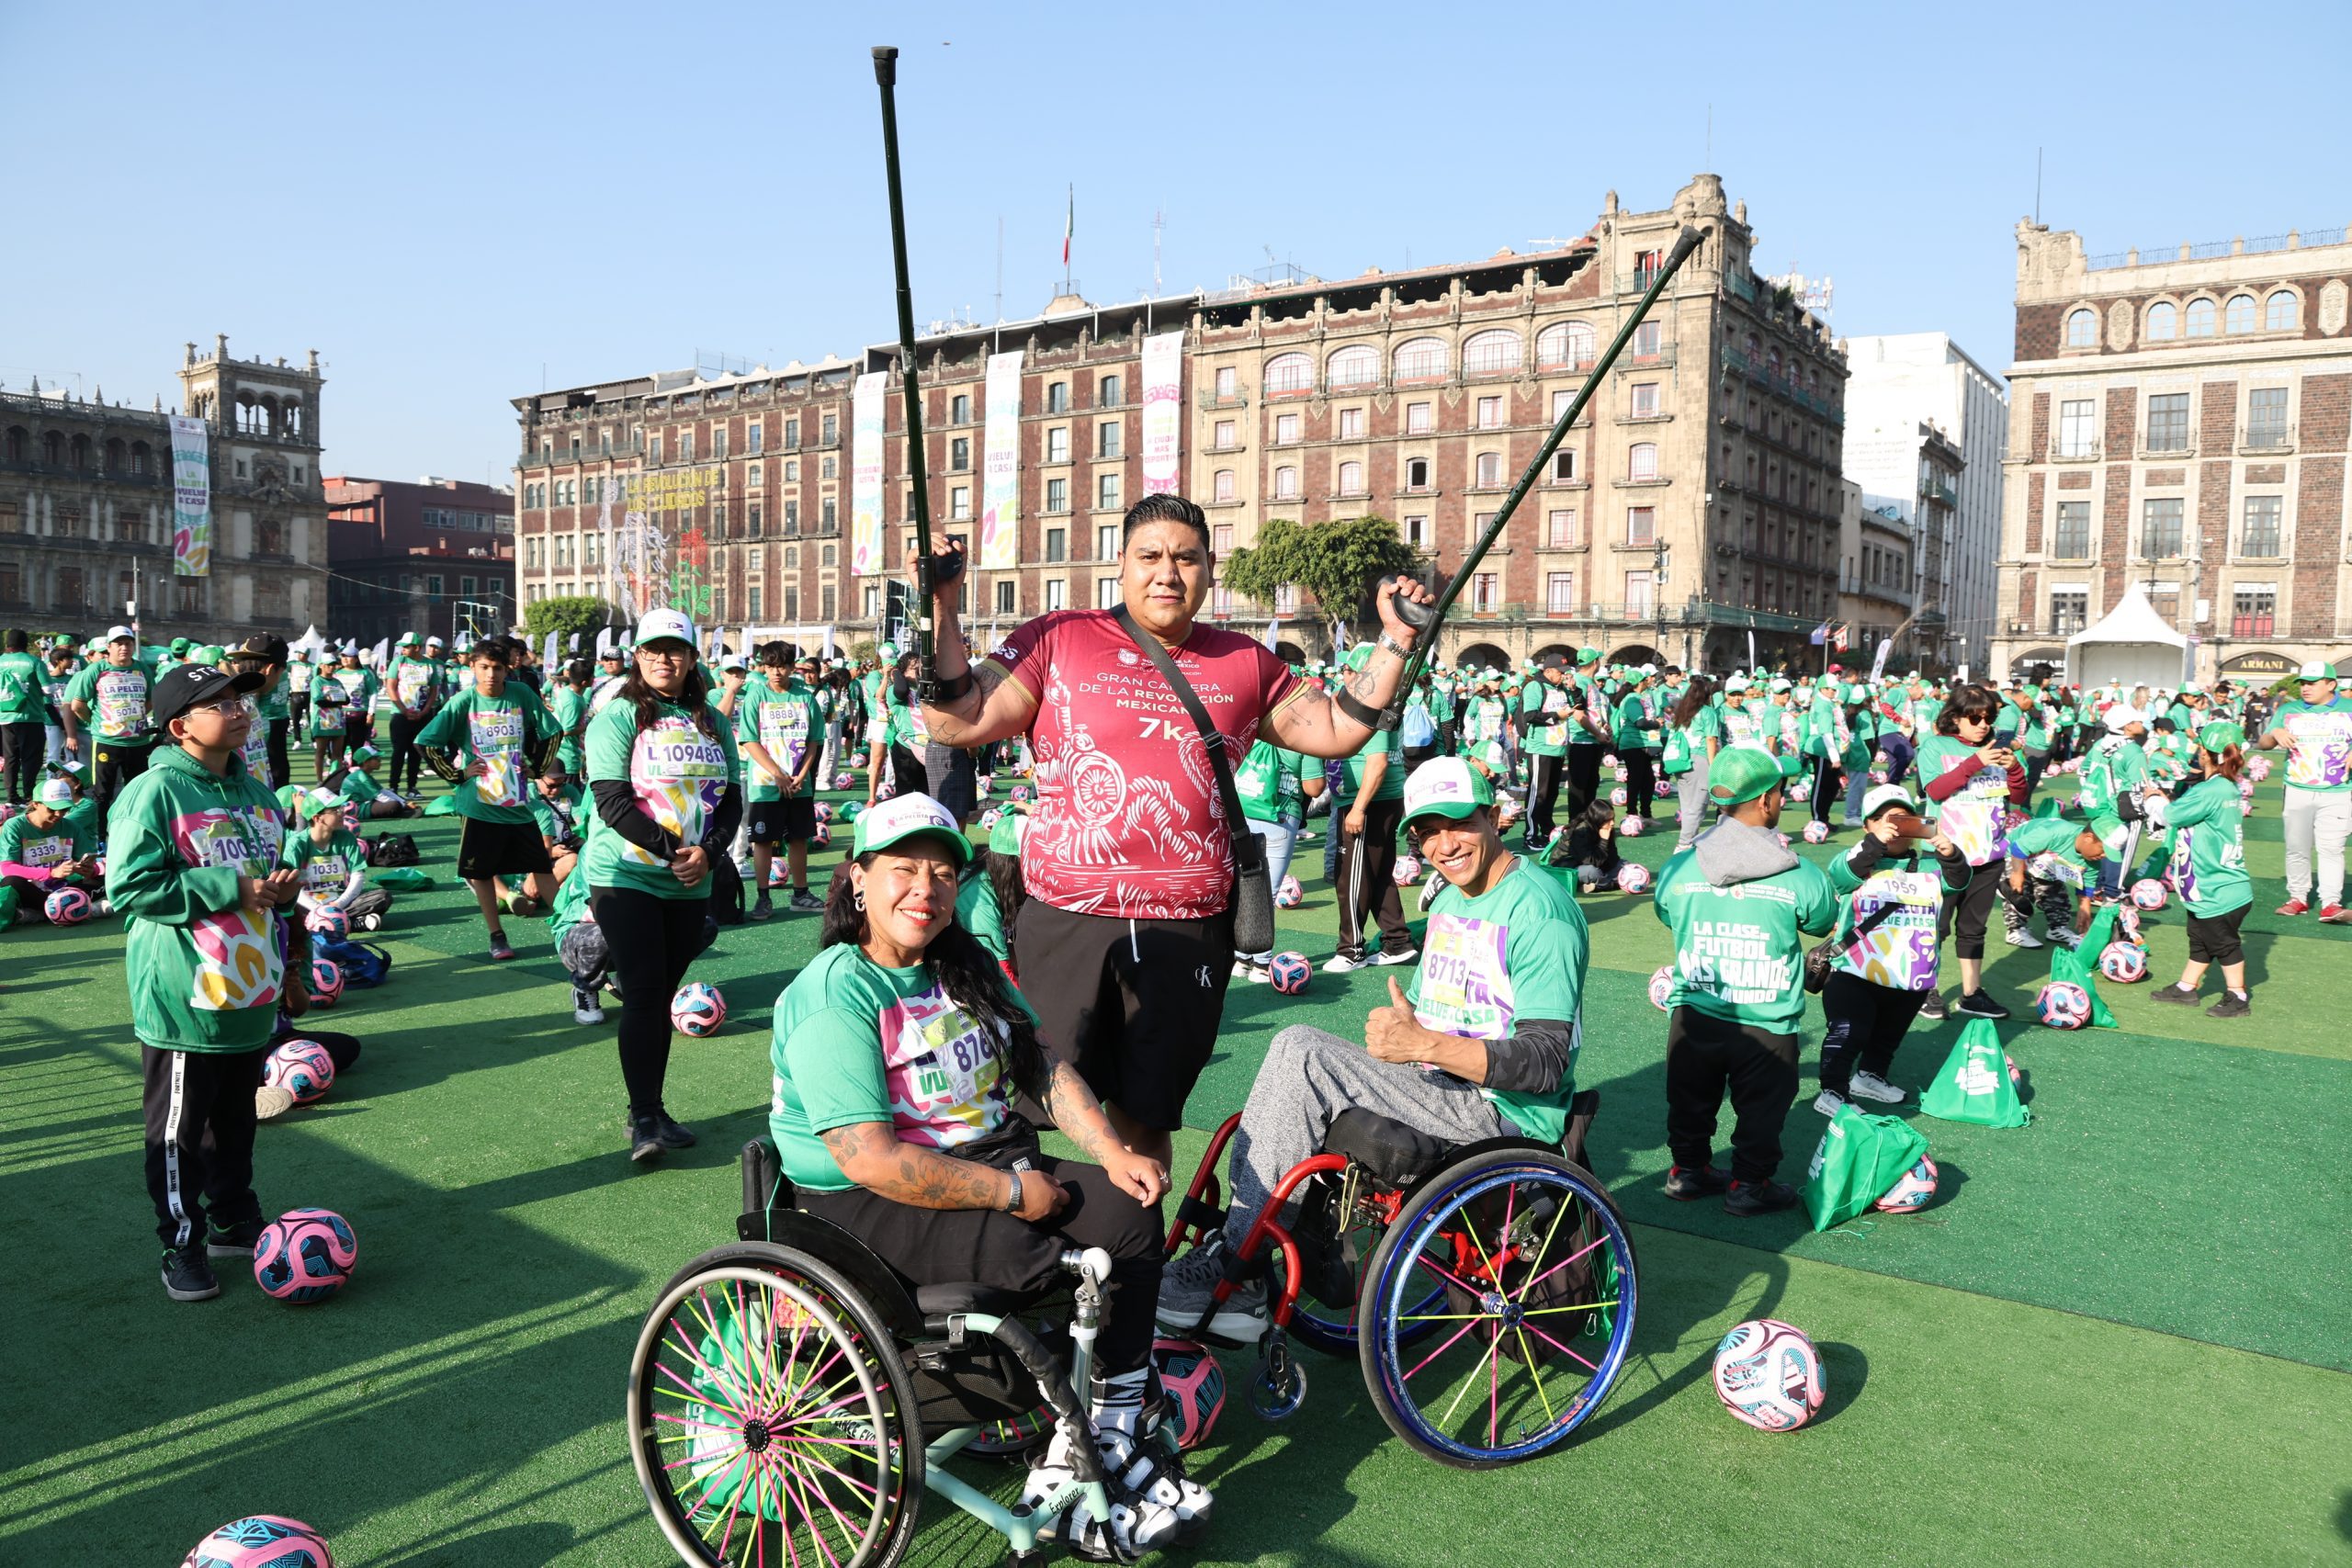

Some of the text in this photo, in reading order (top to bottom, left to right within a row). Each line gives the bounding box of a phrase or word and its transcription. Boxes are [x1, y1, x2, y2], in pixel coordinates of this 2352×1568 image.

[177, 488, 207, 497] VUELVE
[187, 497, 206, 506] CASA
[2241, 660, 2283, 670] ARMANI
[1097, 672, 1221, 693] GRAN CAERA
[1079, 683, 1234, 704] DE LA REVOCIÓN
[116, 707, 137, 716] 5074
[486, 725, 514, 737] 8903
[662, 745, 714, 763] 10948
[30, 844, 56, 858] 3339
[312, 863, 339, 874] 1033
[1883, 879, 1917, 896] 1959
[1860, 898, 1879, 913] LA
[1693, 921, 1713, 935] LA
[1716, 922, 1761, 939] CLASE
[1693, 935, 1771, 960] FUTBOL
[1428, 953, 1467, 987] 8713
[1719, 954, 1792, 991] GRANDE
[1689, 981, 1778, 1005] DEL MUNDO
[174, 1071, 182, 1095] FORTNITE
[169, 1104, 180, 1129] FORTNITE
[170, 1168, 178, 1192] FORTNITE
[1048, 1487, 1080, 1516] Explorer
